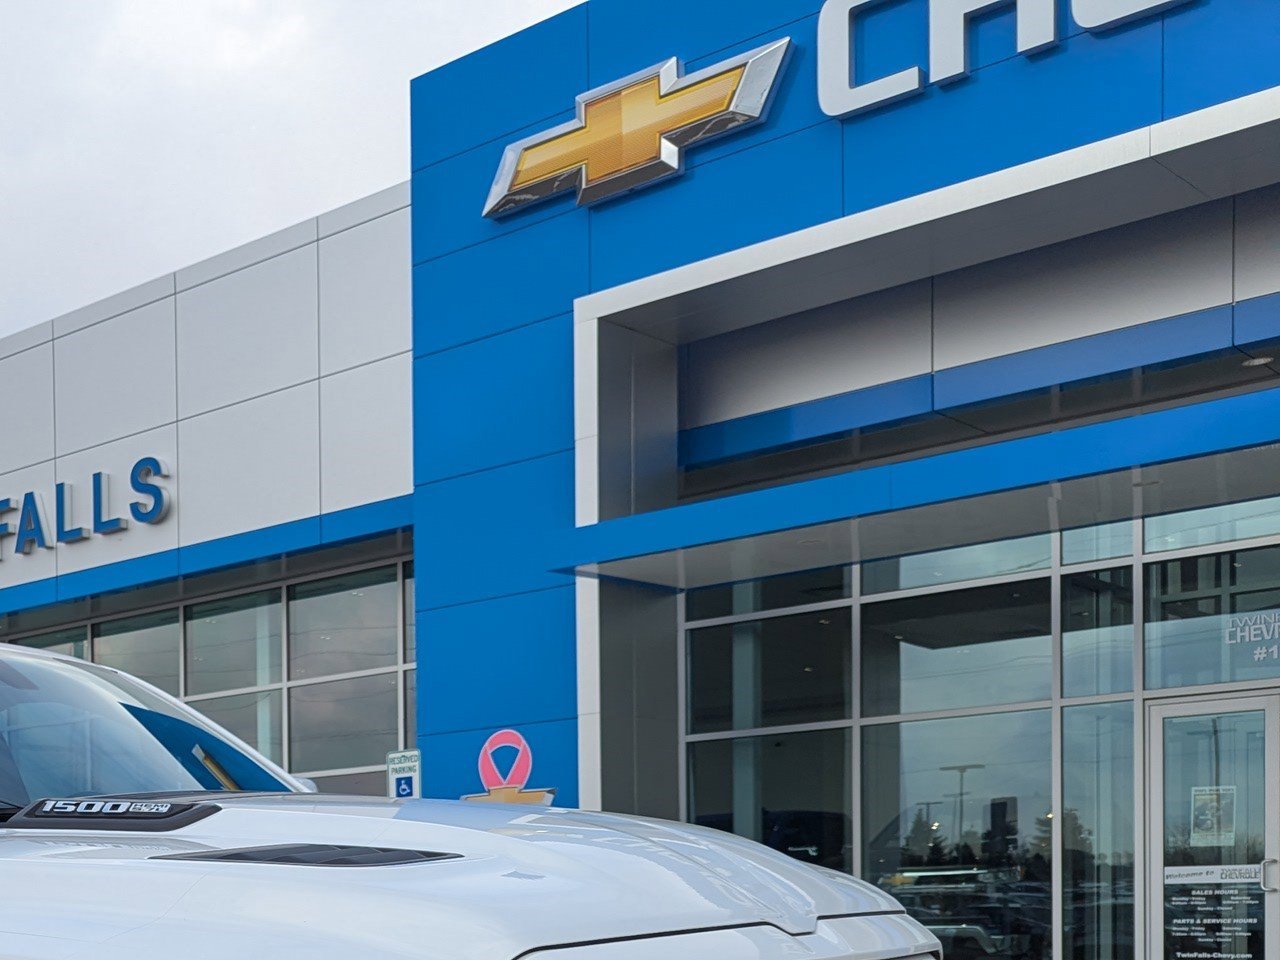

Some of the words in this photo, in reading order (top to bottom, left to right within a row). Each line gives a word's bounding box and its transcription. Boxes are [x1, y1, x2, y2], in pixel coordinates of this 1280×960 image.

[817, 0, 1192, 119] CH
[389, 754, 418, 765] RESERVED
[391, 765, 417, 775] PARKING
[42, 800, 131, 814] 1500
[1166, 871, 1204, 880] Welcome
